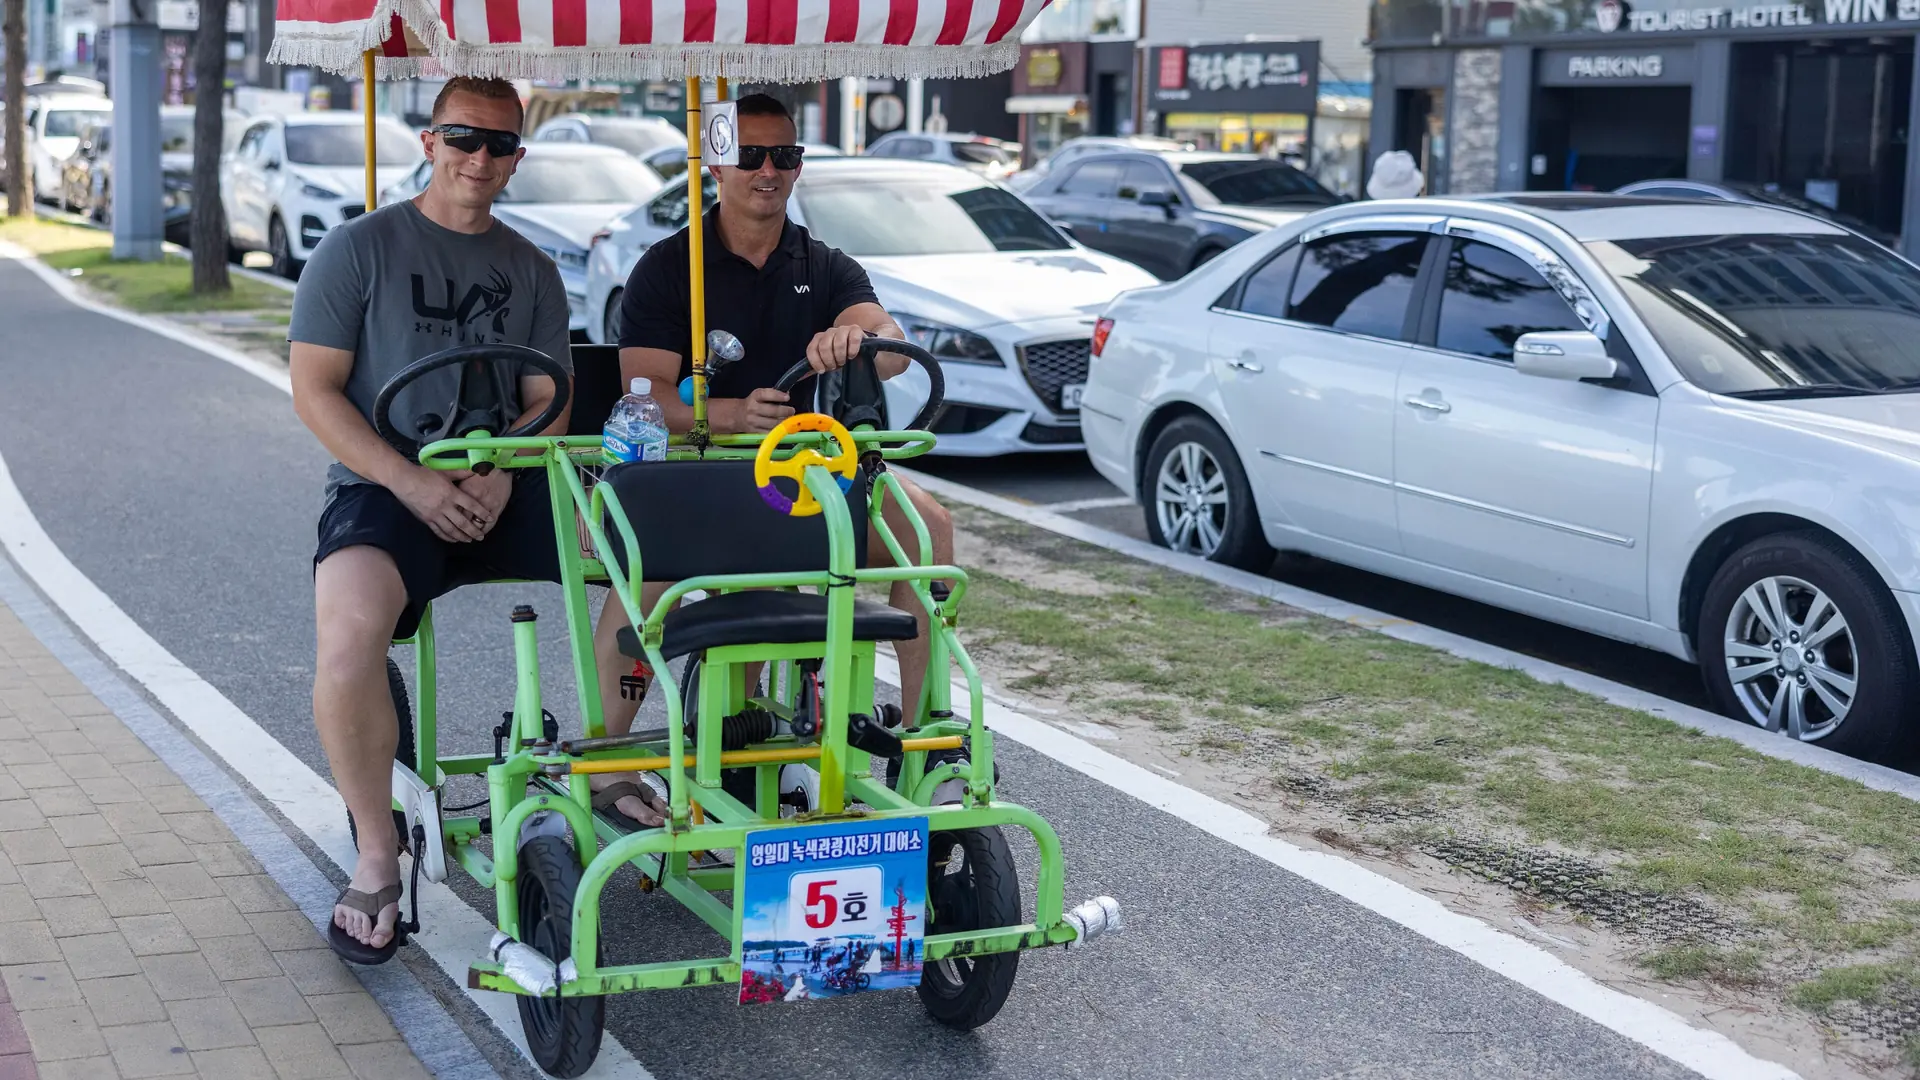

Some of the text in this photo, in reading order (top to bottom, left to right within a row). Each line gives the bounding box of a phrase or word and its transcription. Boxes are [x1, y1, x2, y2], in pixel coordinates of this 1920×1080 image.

[1626, 8, 1722, 32] TOURIST
[1731, 5, 1812, 28] HOTEL
[1824, 0, 1886, 24] WIN
[1568, 55, 1662, 77] PARKING
[752, 830, 921, 866] 영일대 녹색관광자전거 대여소
[805, 880, 868, 929] 5 호
